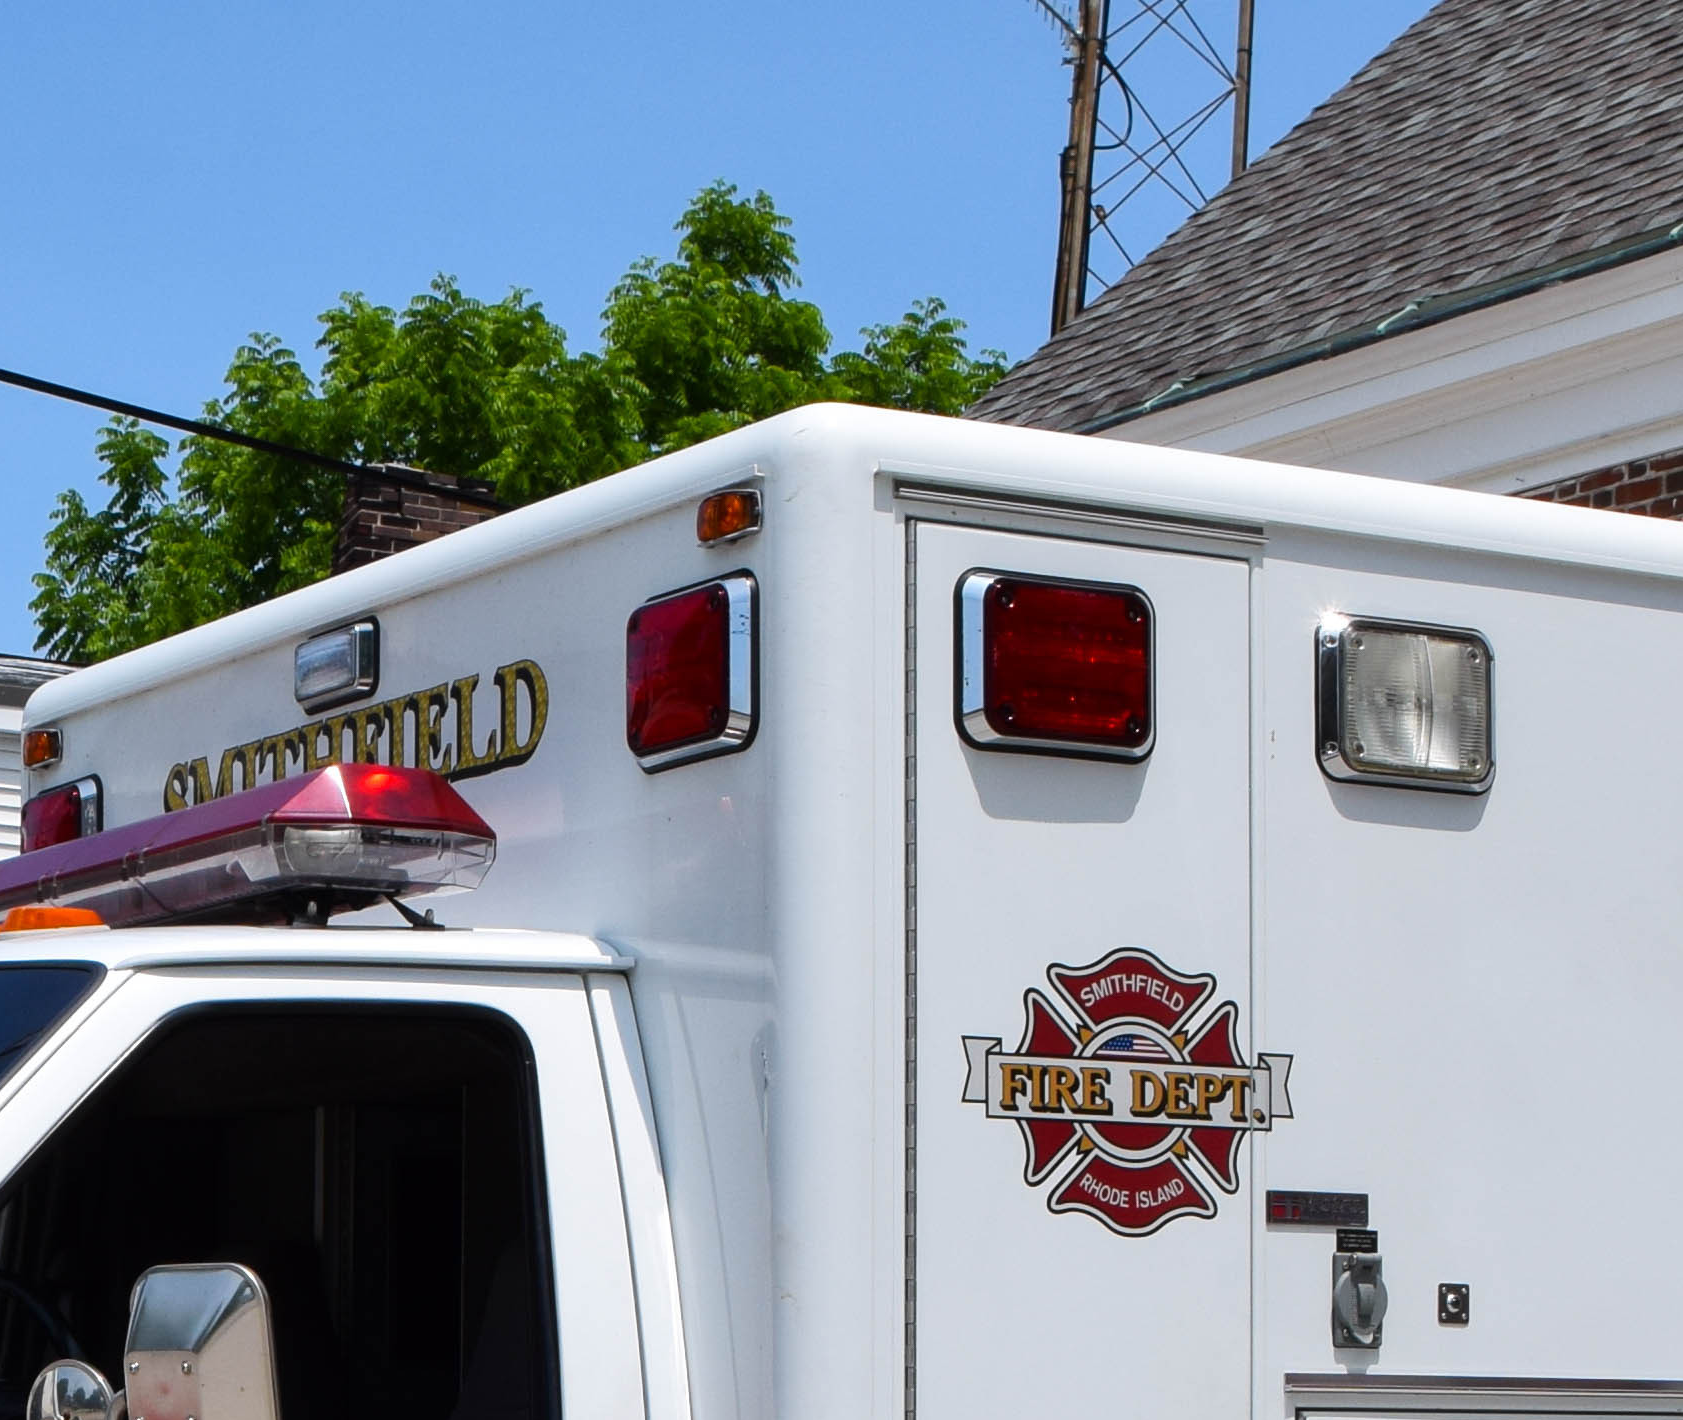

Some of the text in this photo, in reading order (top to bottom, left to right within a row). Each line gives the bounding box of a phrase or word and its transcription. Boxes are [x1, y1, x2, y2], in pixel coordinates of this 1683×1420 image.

[163, 659, 548, 813] SMITHFIELD
[1080, 973, 1185, 1014] SMITHFIELD
[999, 1063, 1265, 1123] FIRE DEPT.
[1080, 1174, 1185, 1209] RHODE ISLAND
